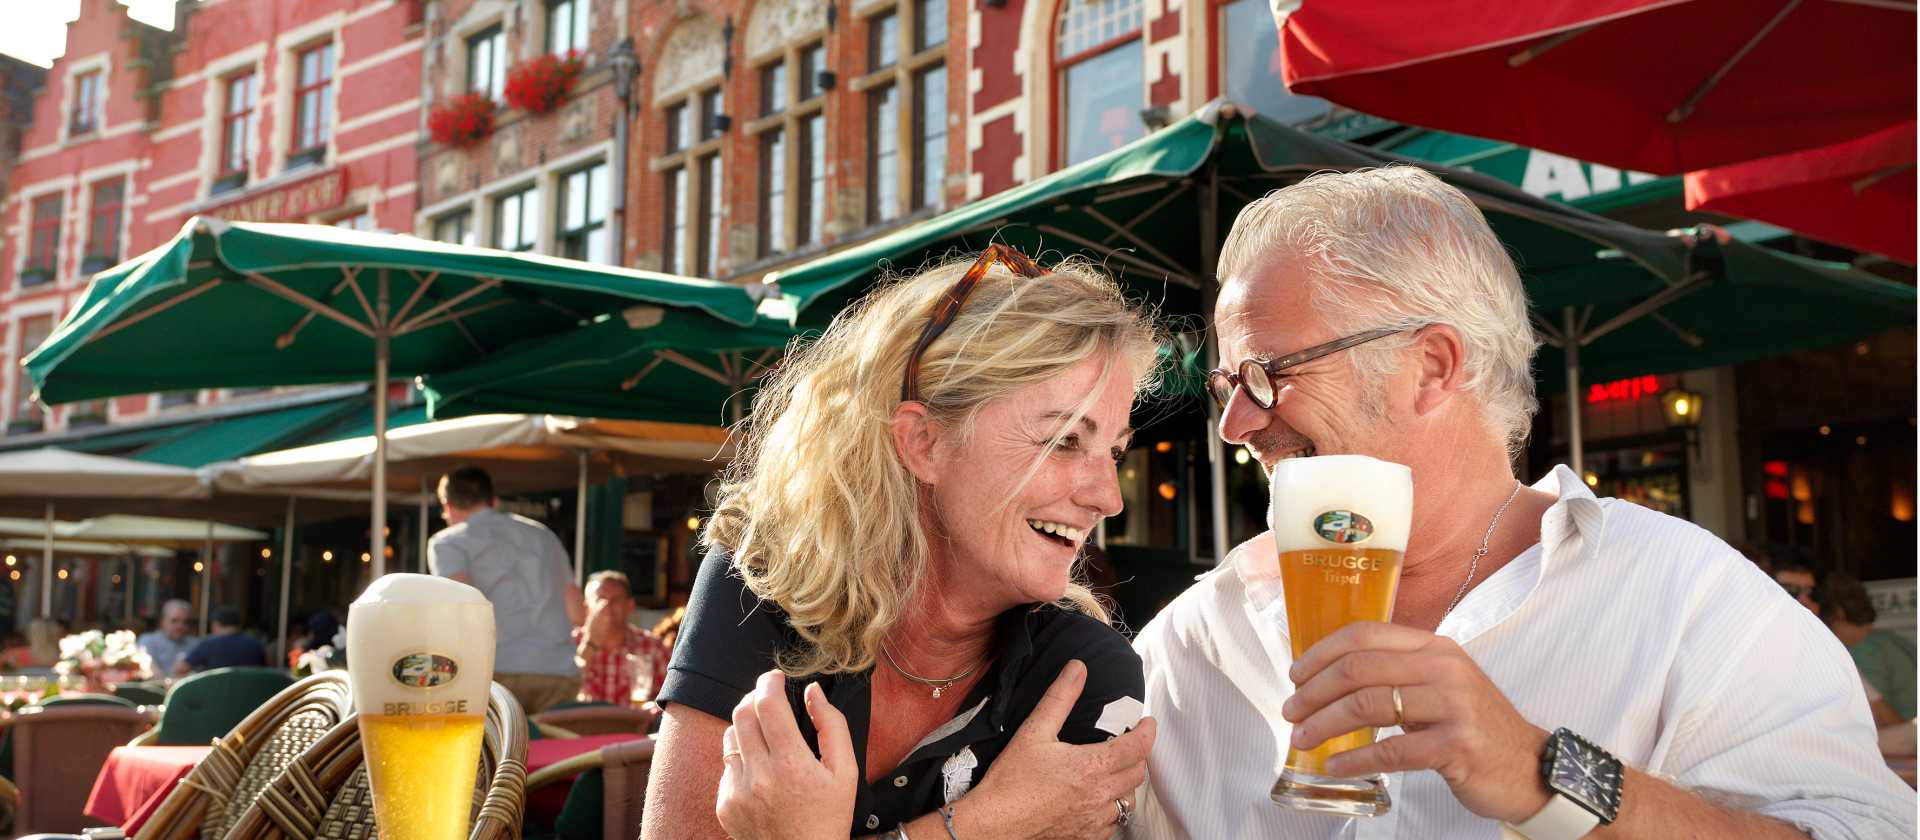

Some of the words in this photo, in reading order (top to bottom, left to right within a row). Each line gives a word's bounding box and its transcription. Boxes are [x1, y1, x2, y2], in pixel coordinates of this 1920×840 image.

[1303, 553, 1384, 571] BRUGGE
[1323, 571, 1360, 585] Tripel
[383, 700, 468, 716] BRUGGE
